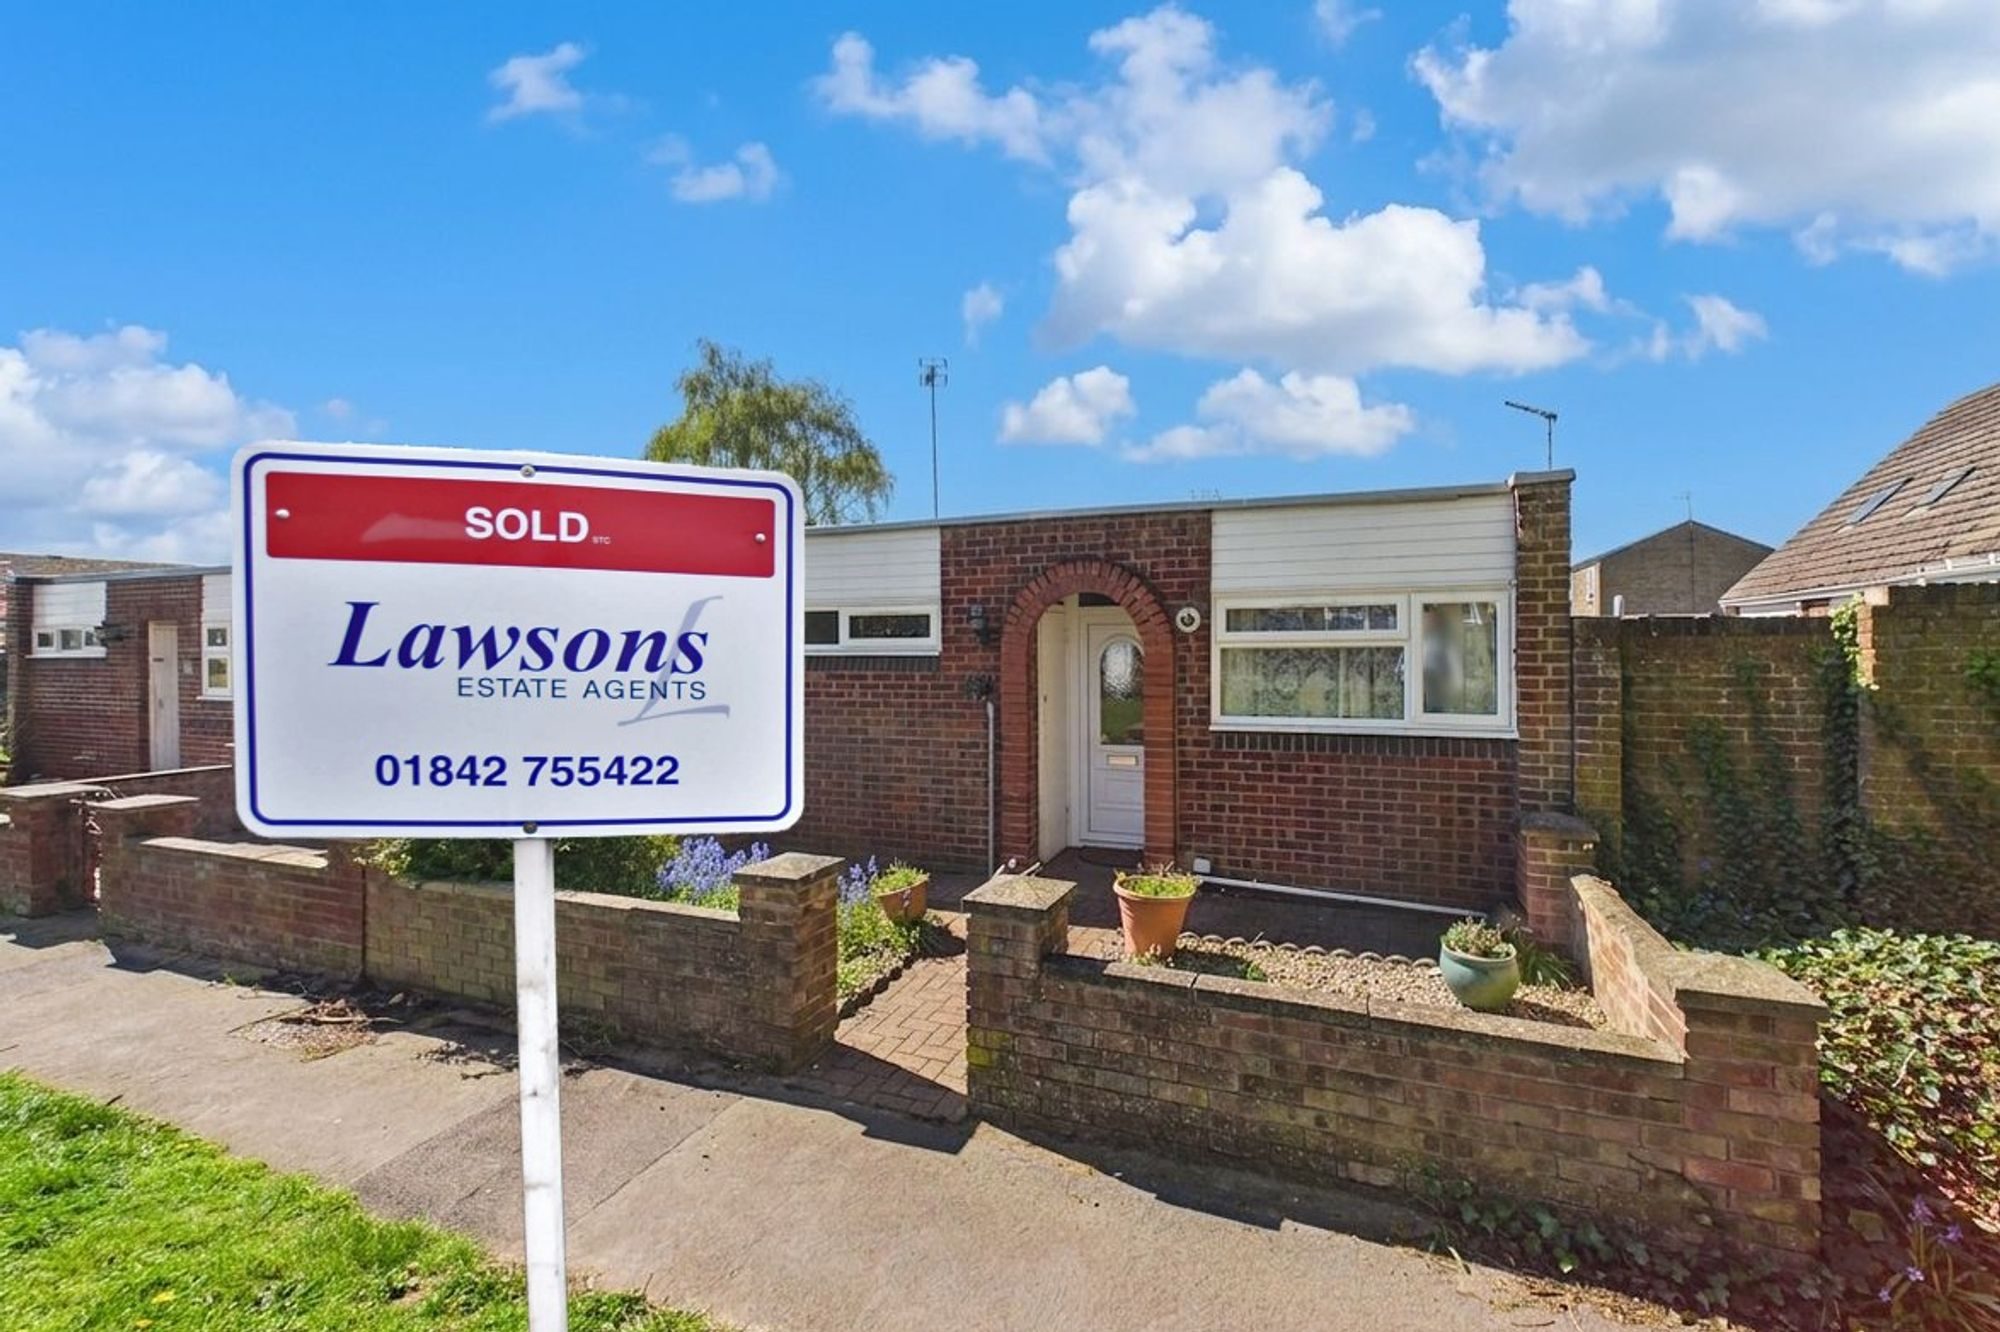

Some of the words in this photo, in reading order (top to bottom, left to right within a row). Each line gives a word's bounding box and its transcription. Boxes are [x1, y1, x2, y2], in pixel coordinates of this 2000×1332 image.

[465, 506, 590, 544] SOLD
[592, 536, 612, 545] STC
[328, 601, 709, 675] Lawsons
[458, 676, 567, 699] ESTATE
[583, 679, 706, 700] AGENTS
[375, 754, 507, 787] 01842
[522, 755, 680, 787] 755422
